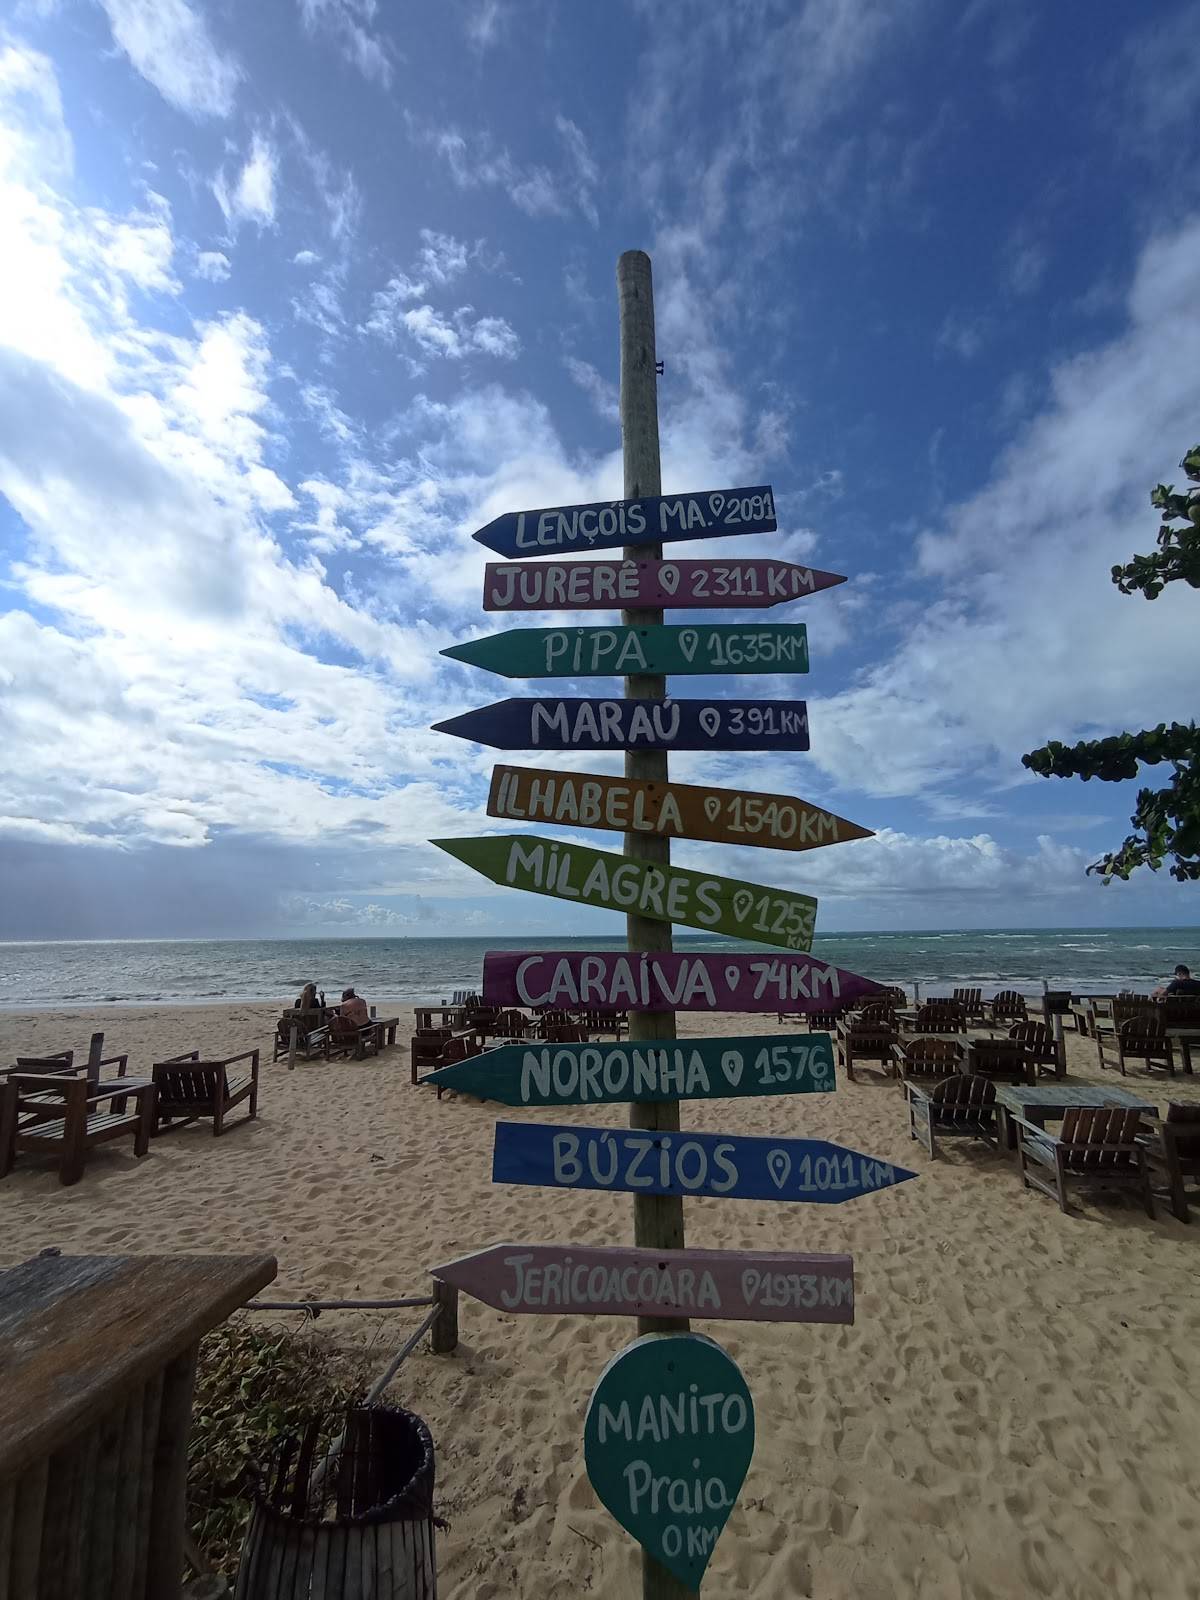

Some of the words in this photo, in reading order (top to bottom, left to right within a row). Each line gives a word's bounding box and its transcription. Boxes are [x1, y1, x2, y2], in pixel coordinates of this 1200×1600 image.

[492, 560, 640, 606] JURERÊ
[531, 700, 680, 744] MARAÚ
[786, 934, 811, 951] KM
[516, 952, 716, 1007] CARAÍVA
[521, 1048, 710, 1102] NORONHA
[755, 1045, 828, 1084] 1576
[623, 1458, 734, 1514] Praia
